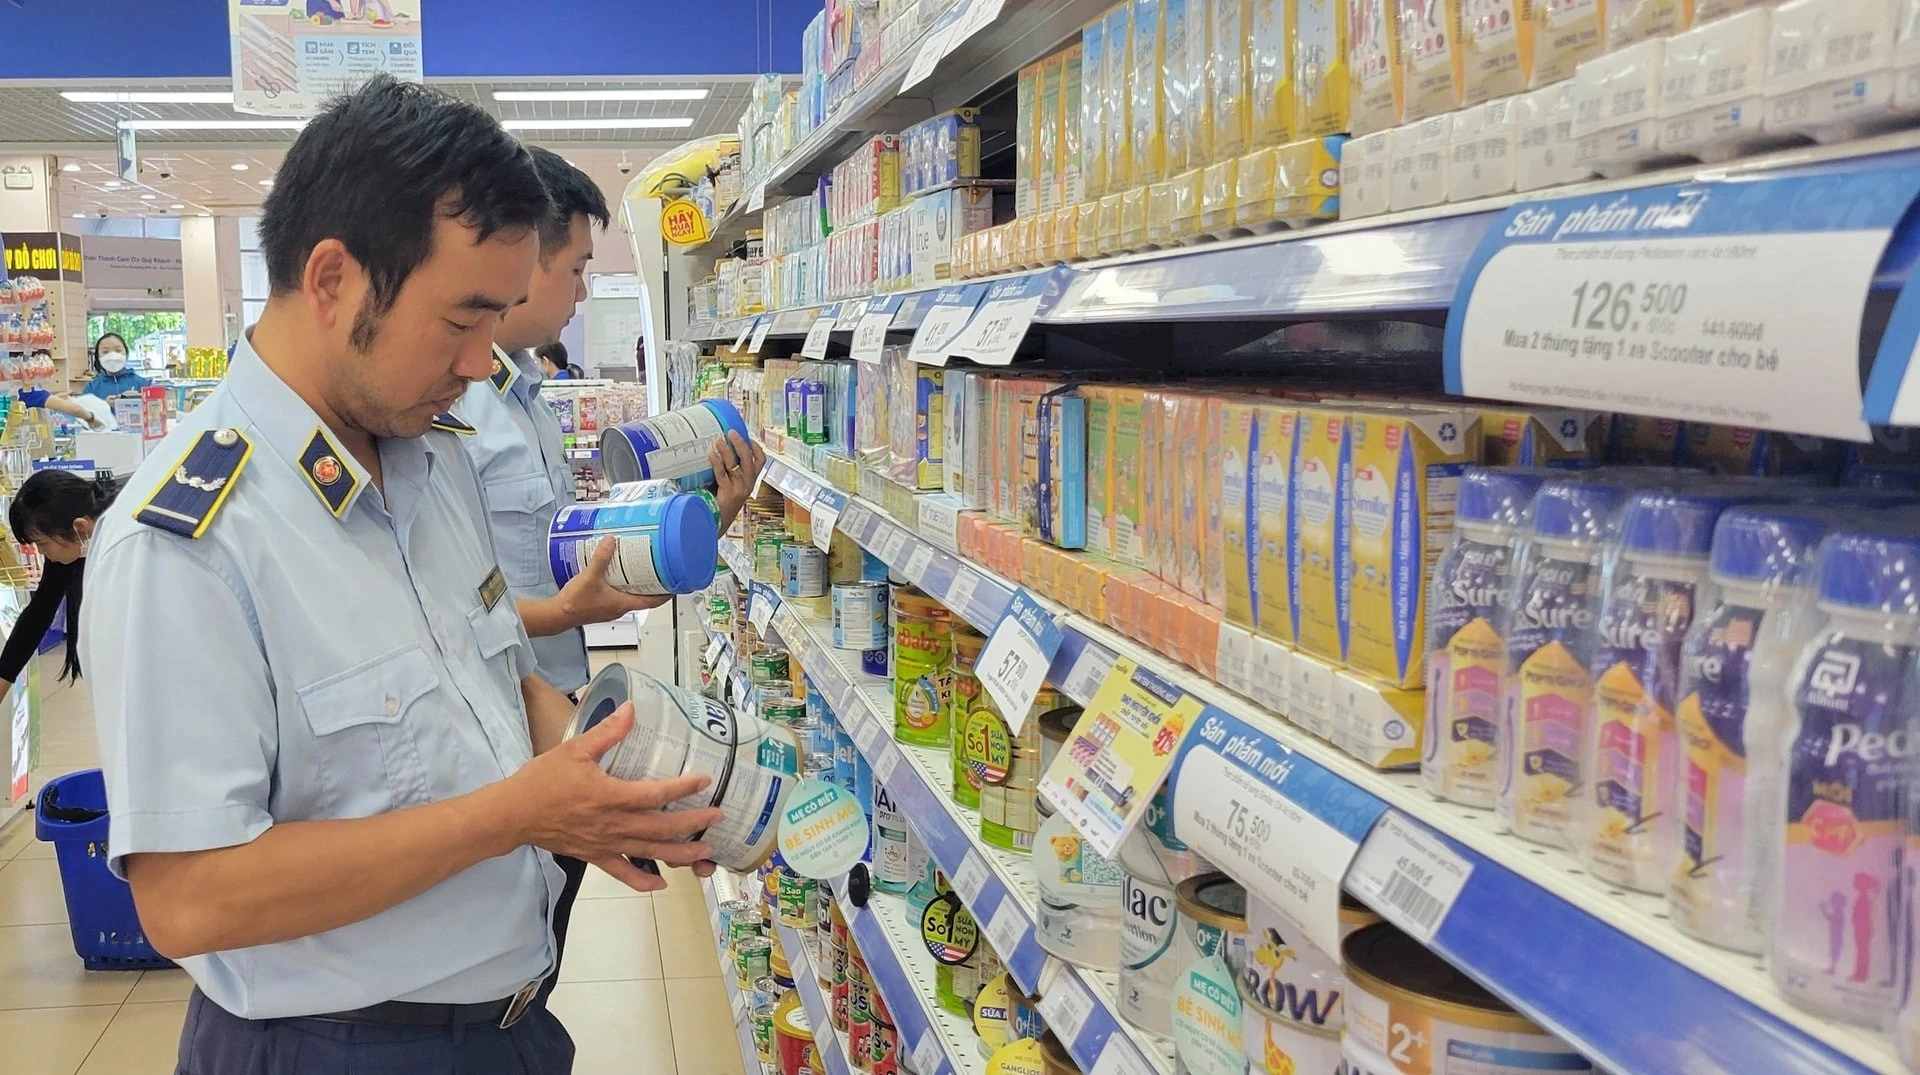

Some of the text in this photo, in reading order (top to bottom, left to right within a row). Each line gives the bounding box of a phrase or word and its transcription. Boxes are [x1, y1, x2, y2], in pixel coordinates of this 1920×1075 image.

[668, 210, 694, 225] HÃY
[14, 242, 30, 270] ĐỒ
[32, 247, 57, 270] CHƠI
[1640, 283, 1689, 316] 500
[1503, 328, 1528, 349] Mua
[1530, 331, 1540, 350] 2
[1617, 338, 1625, 357] 1
[1650, 340, 1713, 367] Scooter
[1716, 345, 1750, 370] cho
[803, 802, 818, 815] CÓ
[784, 831, 803, 851] BÉ
[802, 815, 836, 841] SINH
[955, 926, 975, 937] NON
[981, 1007, 1001, 1018] SỮA
[1176, 994, 1193, 1017] BÉ
[1195, 1005, 1226, 1037] SINH
[1391, 1021, 1428, 1065] 2+
